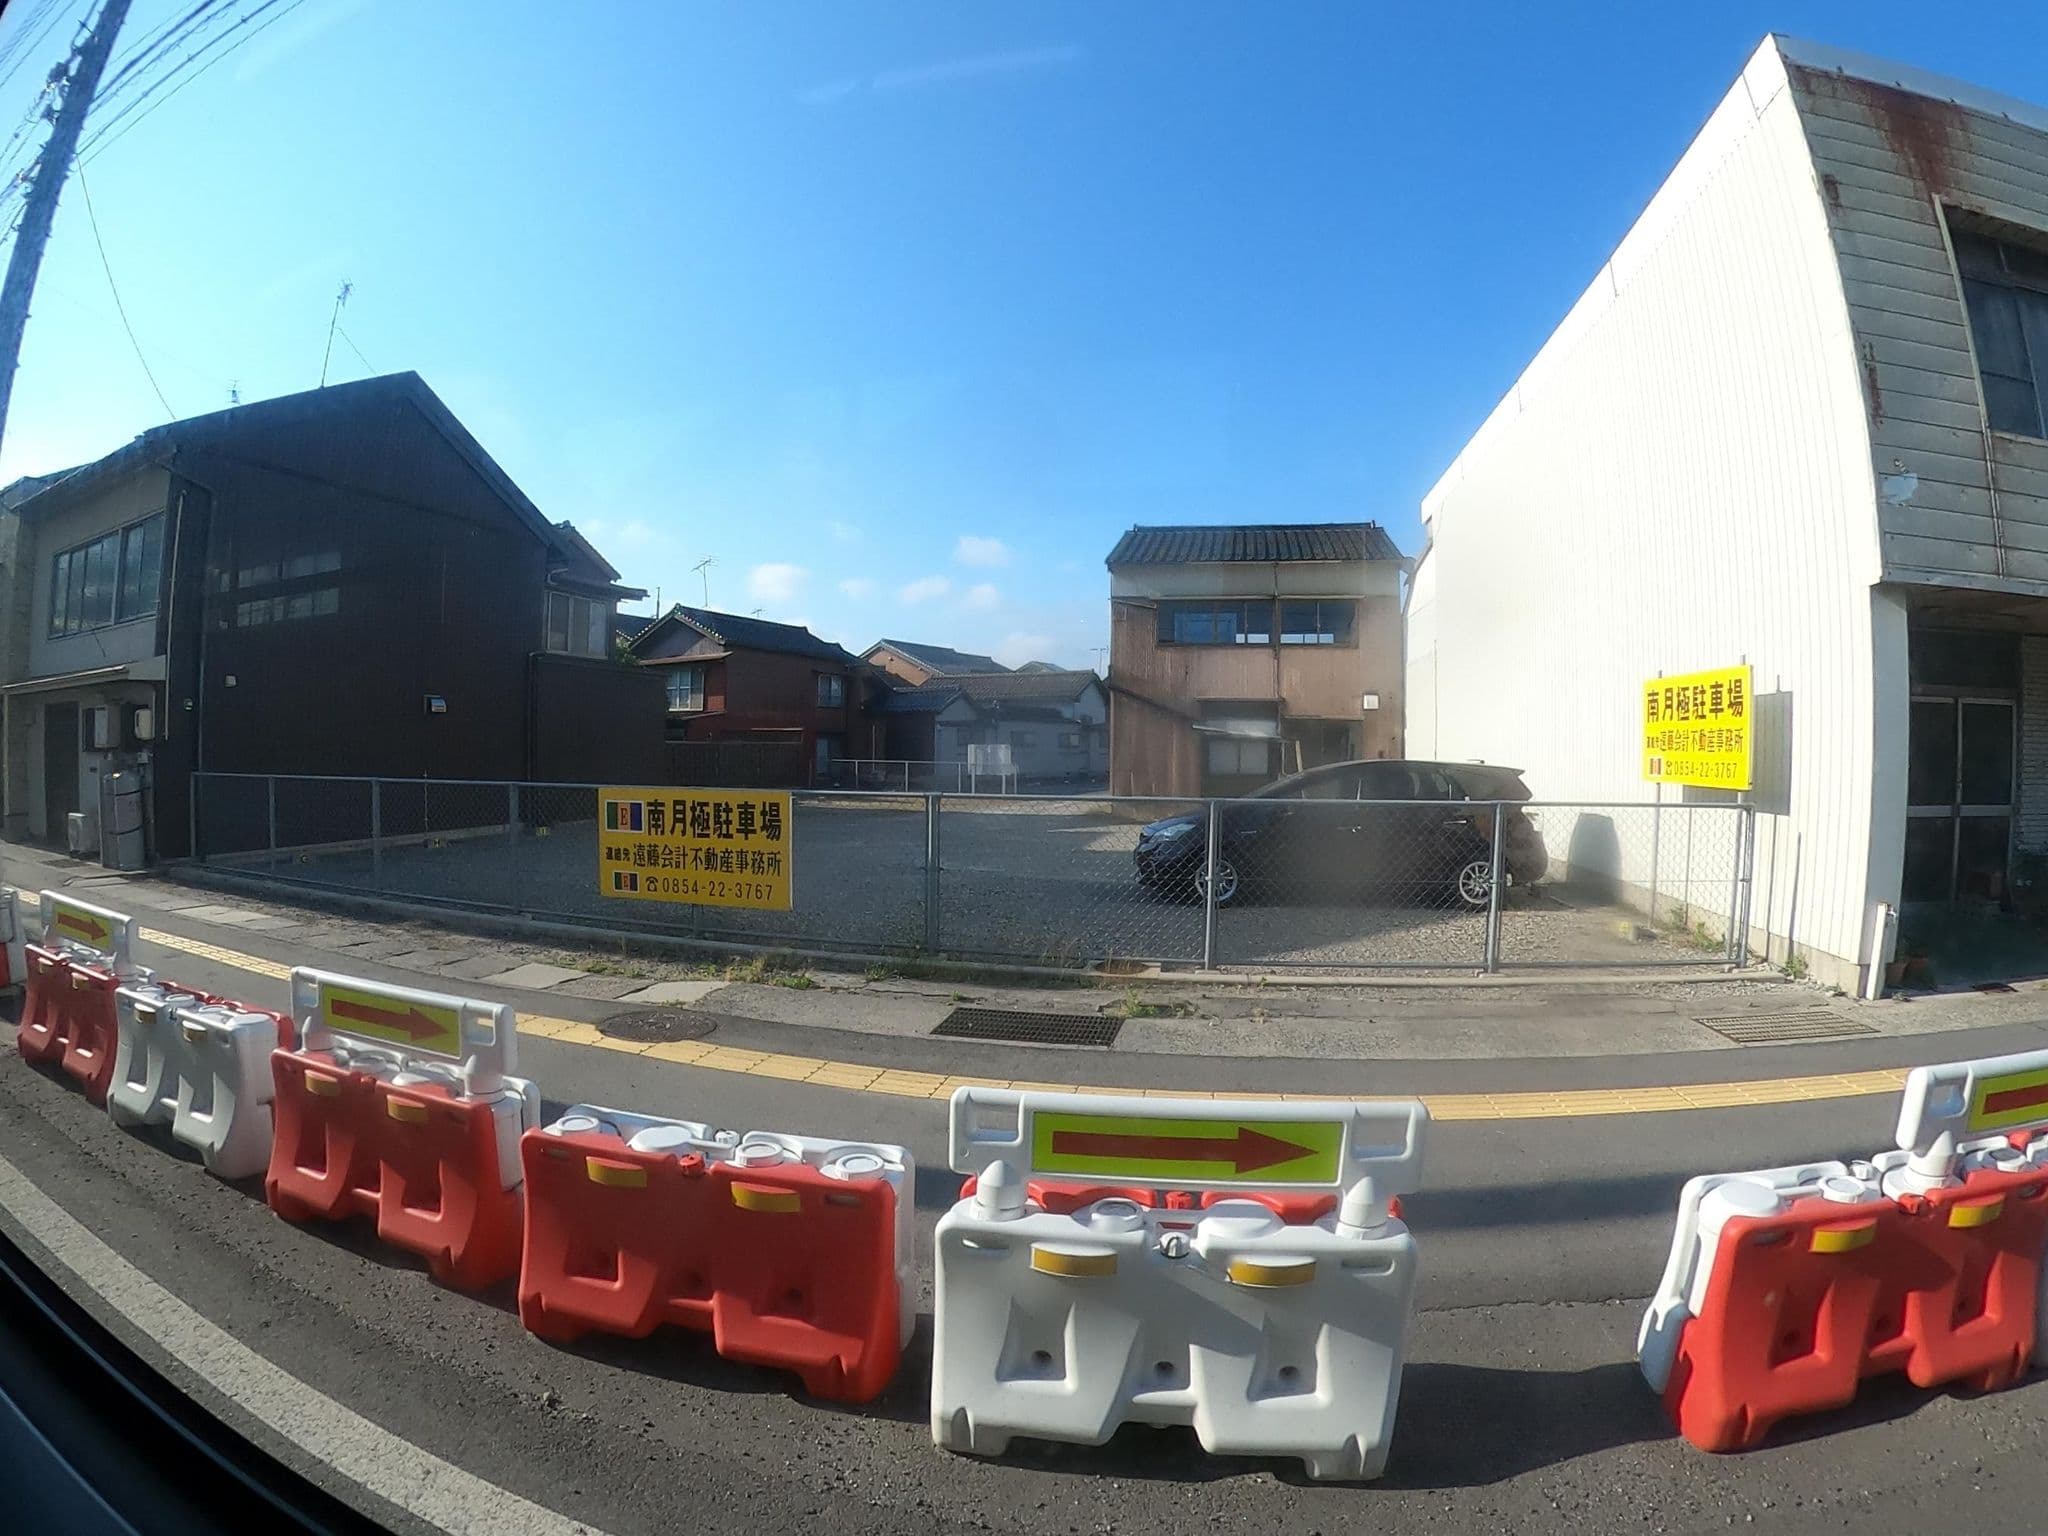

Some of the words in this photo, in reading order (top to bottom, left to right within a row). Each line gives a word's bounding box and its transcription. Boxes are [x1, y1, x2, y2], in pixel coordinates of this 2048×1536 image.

[1647, 678, 1744, 723] 南月極駐車場
[619, 806, 629, 826] E
[646, 799, 782, 842] 南月極駐車場
[633, 843, 781, 877] 遠藤会計不動産事務所
[662, 877, 773, 901] 0854-22-3767
